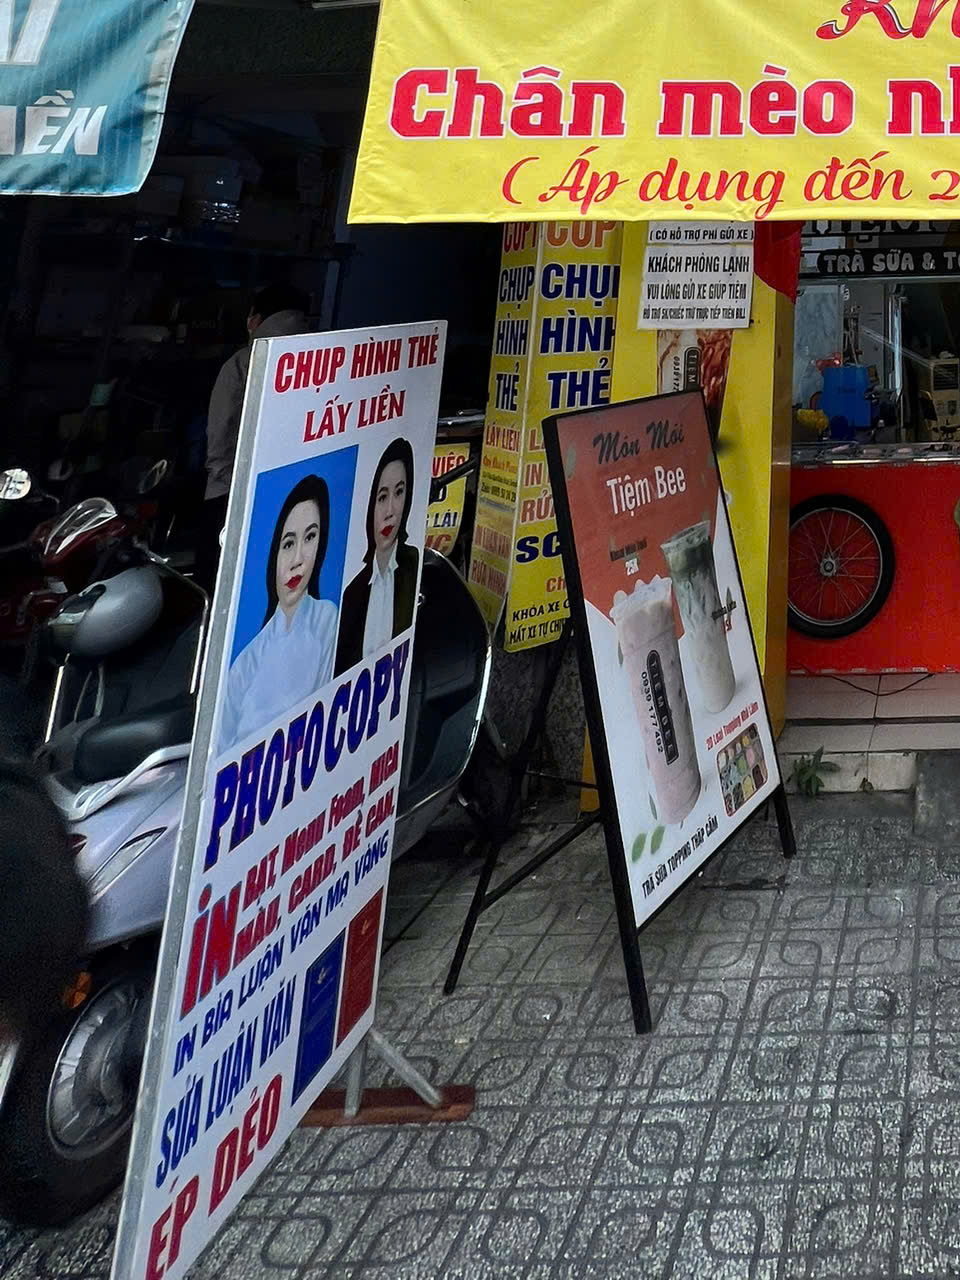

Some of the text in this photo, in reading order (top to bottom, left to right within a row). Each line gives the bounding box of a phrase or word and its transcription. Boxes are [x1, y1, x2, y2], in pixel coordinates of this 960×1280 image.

[388, 63, 630, 141] Chân
[656, 63, 854, 139] mèo
[639, 153, 788, 220] dụng
[803, 150, 914, 201] đến
[647, 252, 750, 277] KHÁCH PHÒNG LẠNH
[823, 249, 865, 272] TRÀ
[872, 248, 915, 272] SỮA
[922, 251, 936, 270] &
[499, 265, 536, 309] CHỤP
[646, 283, 659, 300] VUI
[660, 279, 681, 300] LÒNG
[697, 283, 707, 300] XE
[708, 279, 727, 300] GIÚP
[728, 279, 747, 304] TIỆM
[273, 326, 440, 394] CHỤP HÌNH THẺ
[495, 312, 529, 356] HÌNH
[495, 361, 519, 412] THẺ
[547, 357, 612, 409] THẺ
[303, 384, 406, 443] LẤY LIỀN
[592, 431, 641, 465] Món
[606, 465, 687, 517] Tiệm Bee
[203, 638, 411, 874] PHOTOCOPY
[173, 1022, 198, 1079] IN
[238, 934, 286, 1010] LUẬN
[290, 895, 324, 954] VĂN
[325, 870, 350, 917] MẠ
[354, 829, 390, 887] VÀNG
[156, 972, 298, 1189] SỬA LUẬN VĂN
[144, 1073, 283, 1280] ÉP DẺO
